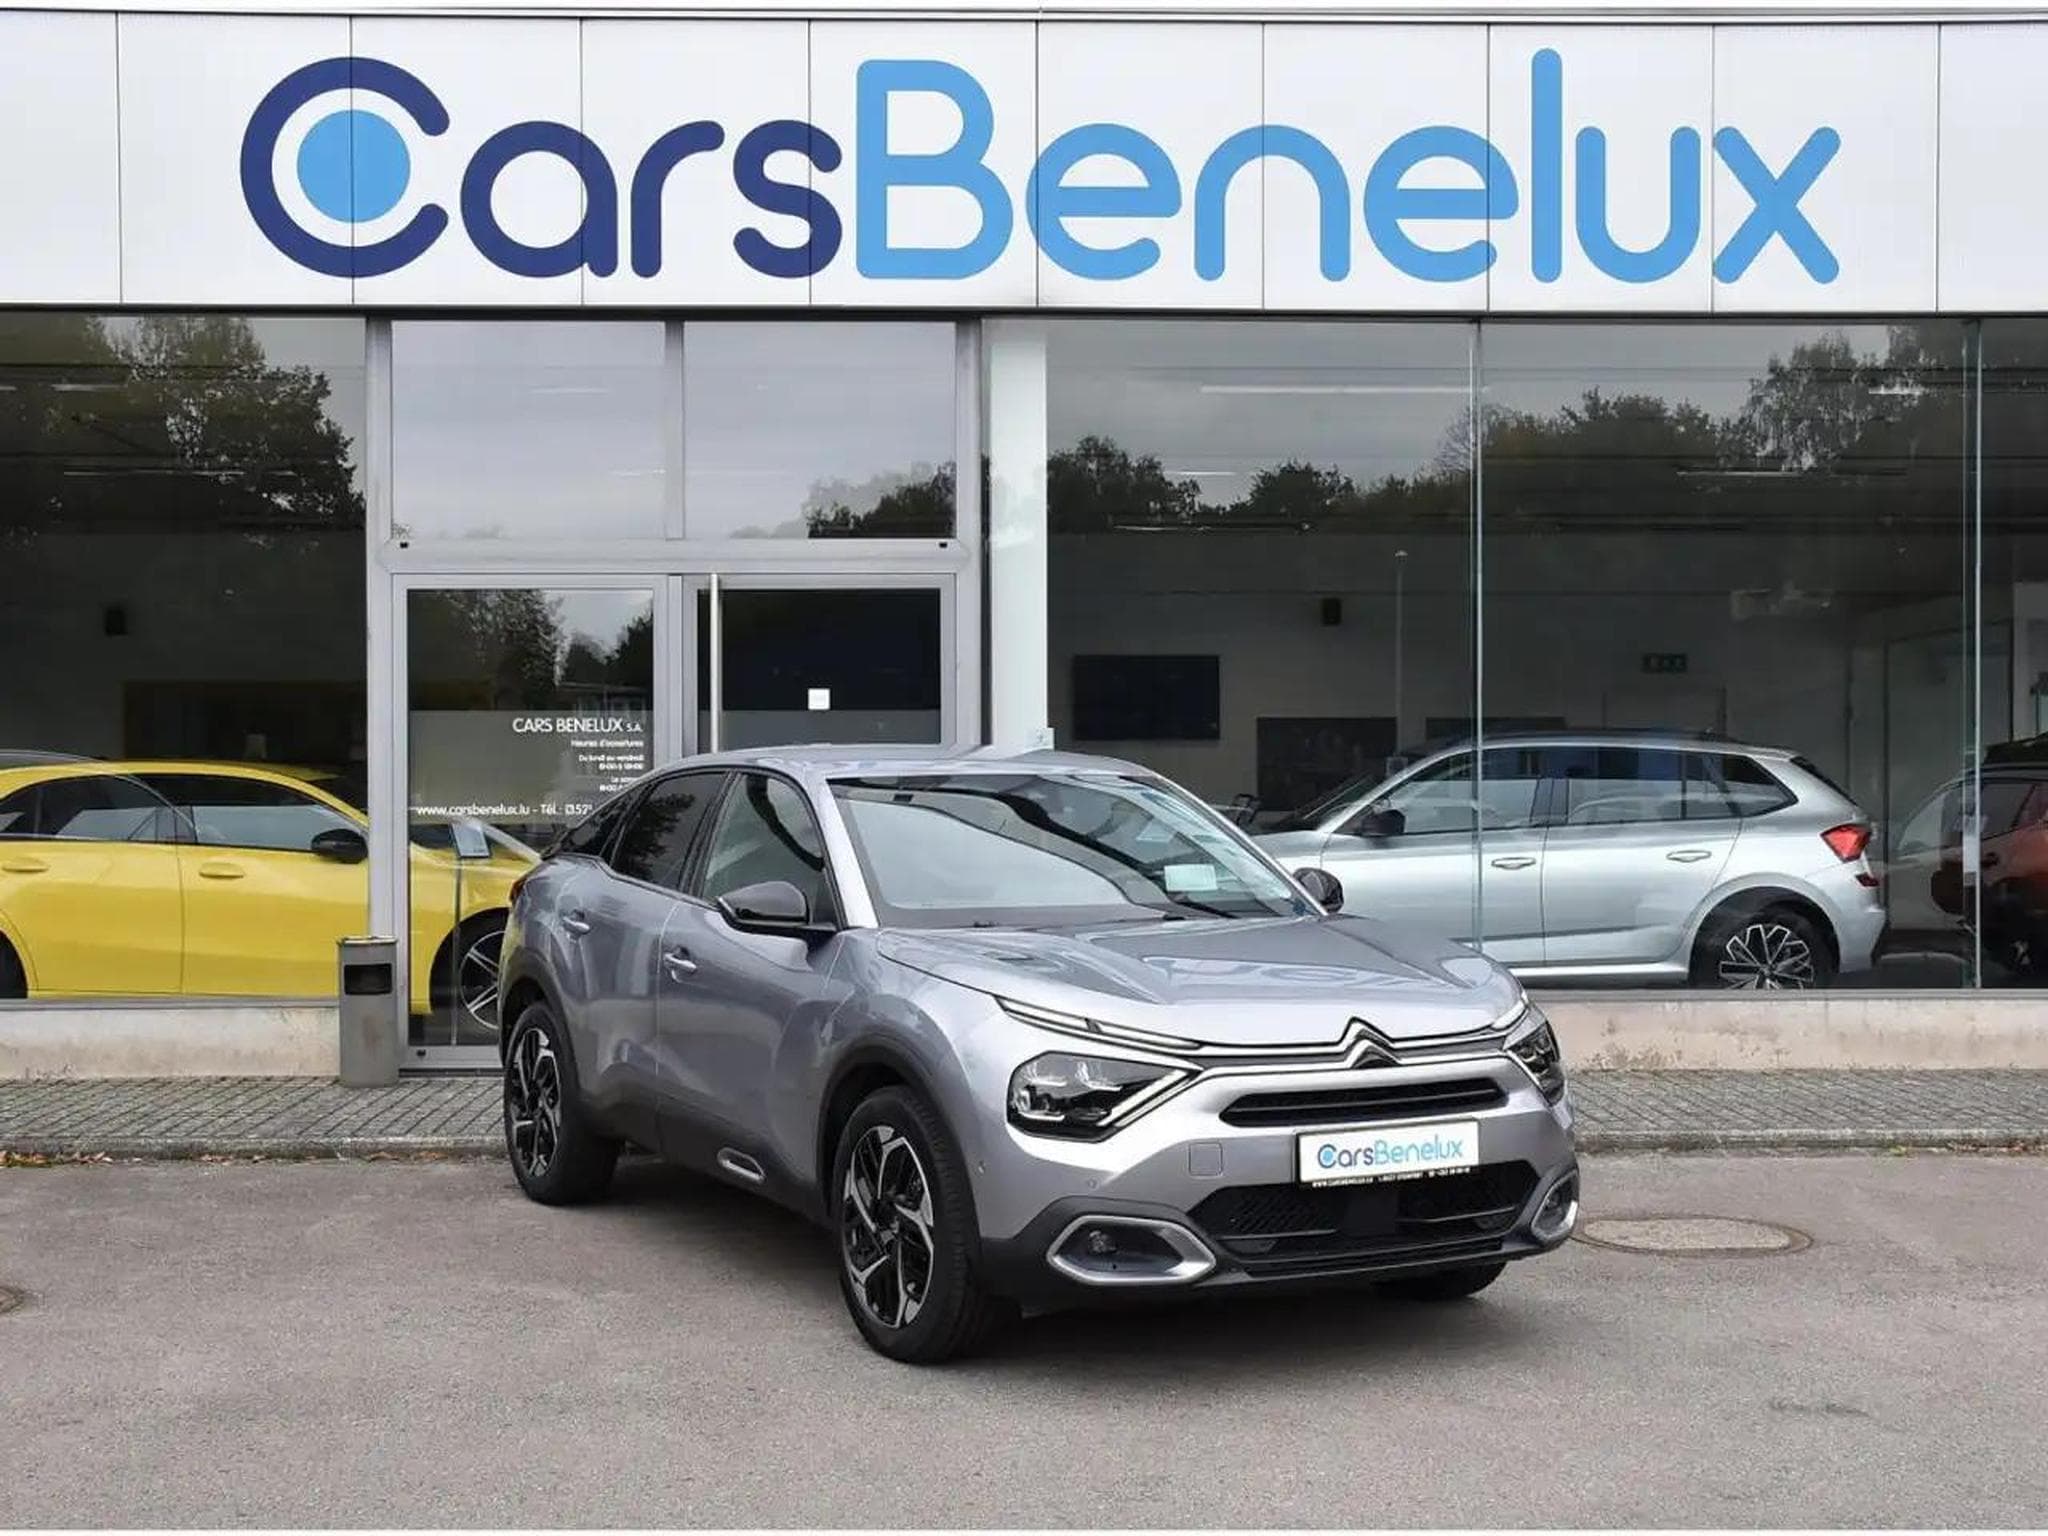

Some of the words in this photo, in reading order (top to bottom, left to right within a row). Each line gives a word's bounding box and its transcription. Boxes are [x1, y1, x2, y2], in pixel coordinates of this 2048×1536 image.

[240, 48, 1841, 283] CarsBenelux
[512, 717, 553, 733] CARS
[556, 717, 623, 733] BENELUX
[417, 802, 530, 816] www.carsbenelux.lu
[1317, 1134, 1463, 1169] CarsBenelux
